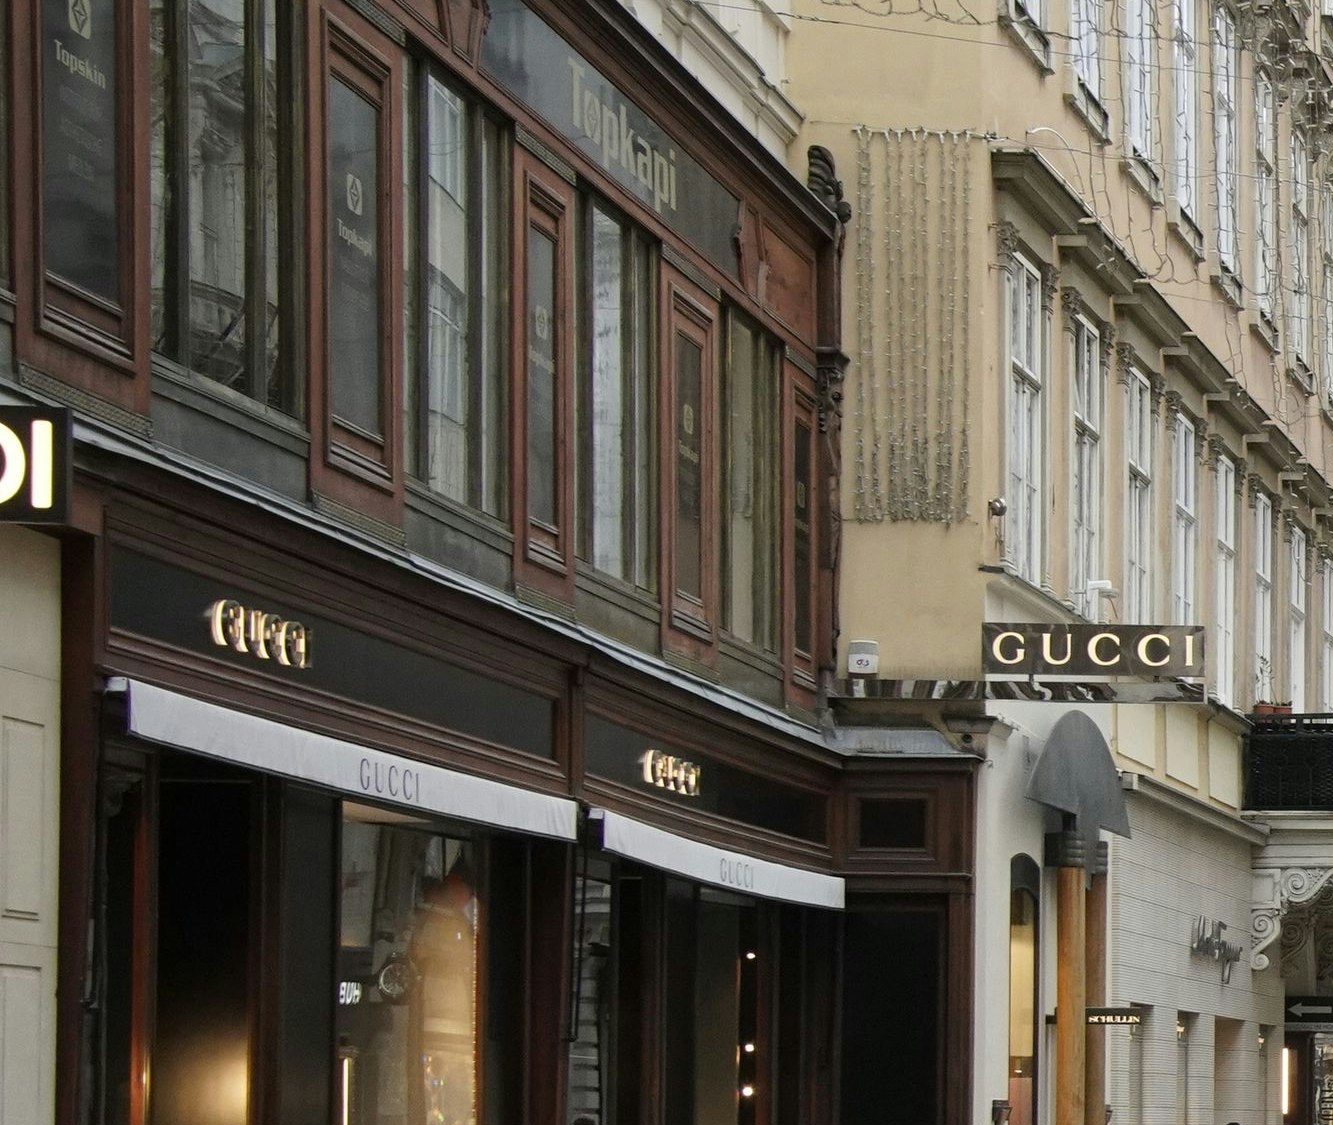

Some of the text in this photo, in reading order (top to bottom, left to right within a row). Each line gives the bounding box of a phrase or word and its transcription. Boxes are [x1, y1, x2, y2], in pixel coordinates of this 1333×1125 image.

[54, 39, 106, 89] Topskin
[568, 55, 676, 213] Topkapi
[992, 631, 1194, 667] GUCCI
[359, 757, 420, 803] GUCCI
[719, 857, 754, 889] GUCCI
[1088, 1015, 1141, 1023] SCHULLIN
